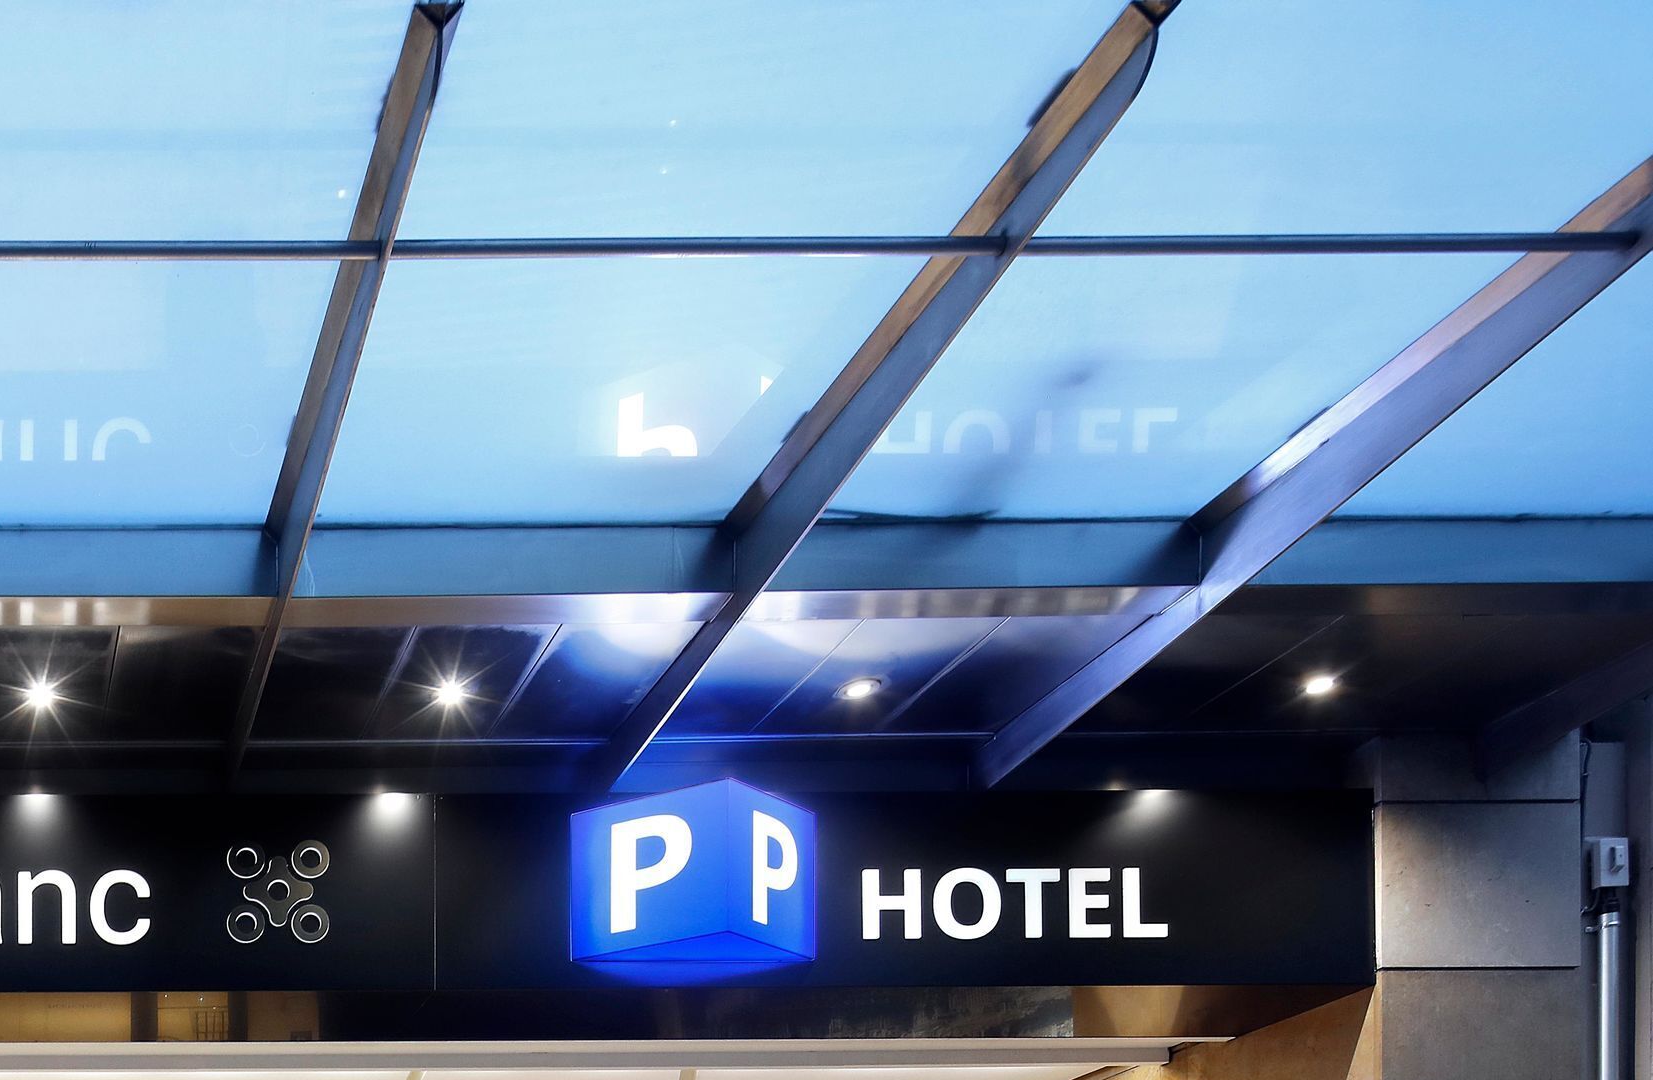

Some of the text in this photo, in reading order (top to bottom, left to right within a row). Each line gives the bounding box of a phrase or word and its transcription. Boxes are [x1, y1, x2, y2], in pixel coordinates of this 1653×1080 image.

[610, 814, 693, 934] P
[752, 809, 798, 926] P
[861, 867, 1169, 940] HOTEL
